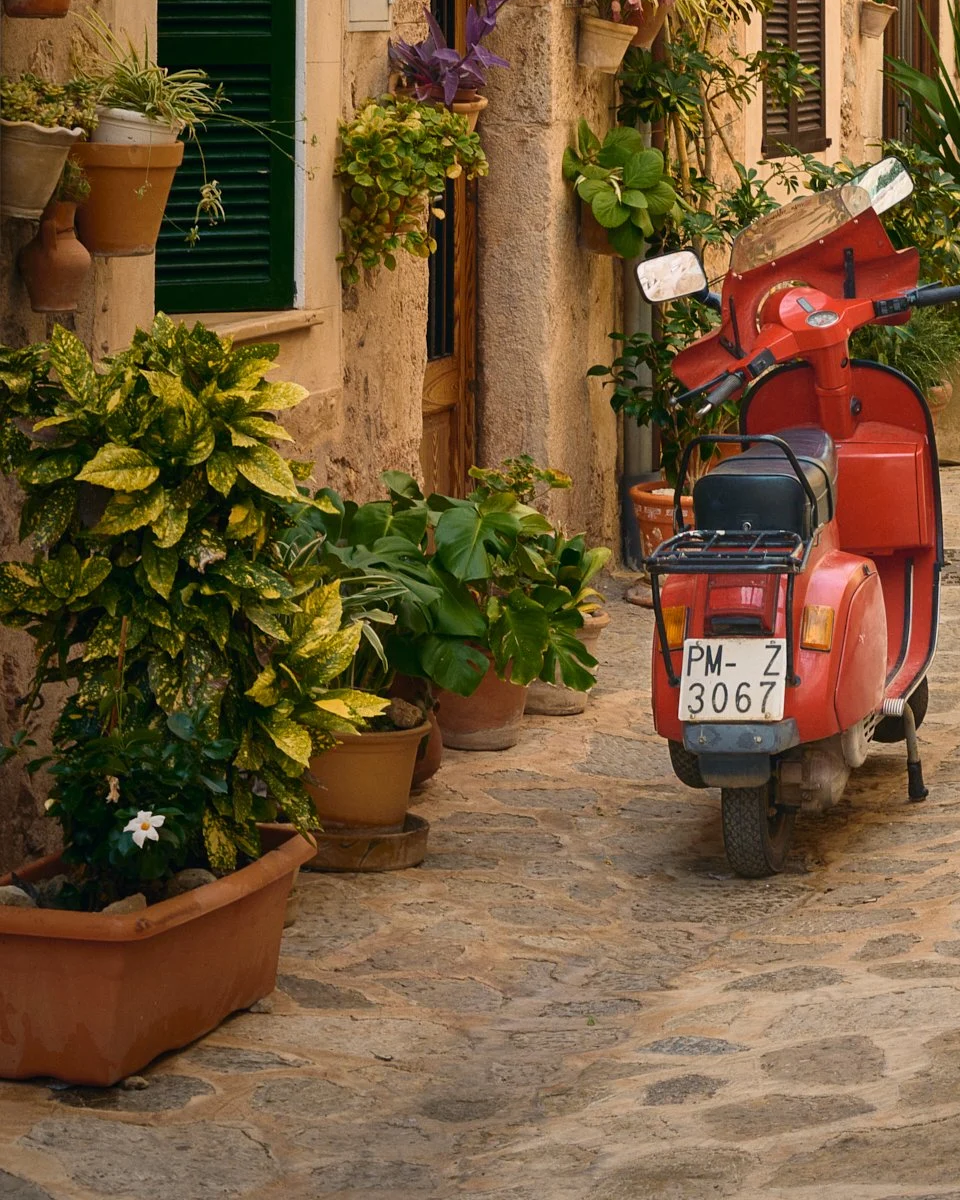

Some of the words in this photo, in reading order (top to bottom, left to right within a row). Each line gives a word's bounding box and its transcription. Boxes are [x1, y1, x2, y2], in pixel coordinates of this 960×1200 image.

[686, 644, 737, 677] PM-
[763, 644, 782, 676] Z
[687, 681, 777, 715] 3067
